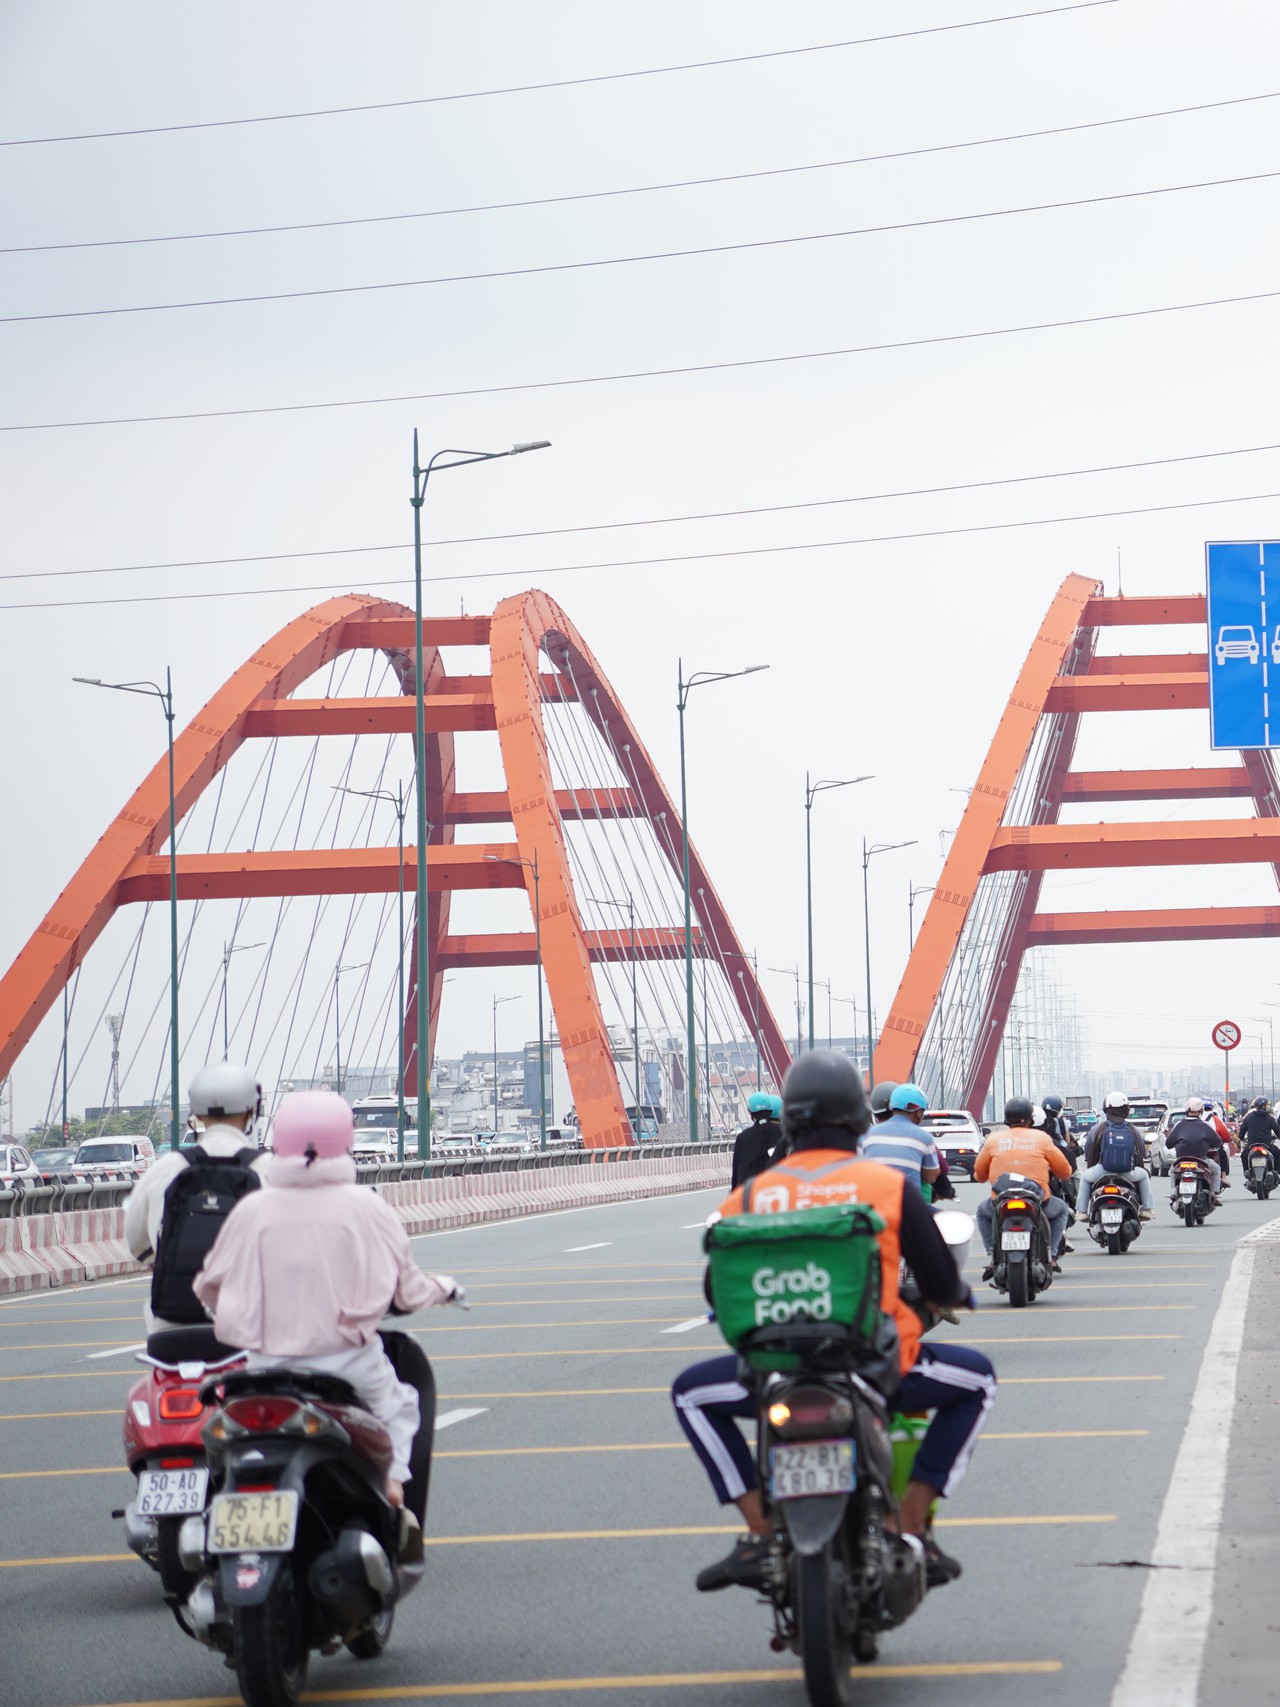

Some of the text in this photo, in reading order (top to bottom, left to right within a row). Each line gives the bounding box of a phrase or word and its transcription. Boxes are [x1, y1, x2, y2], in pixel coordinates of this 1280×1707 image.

[796, 1182, 857, 1197] Shopee
[754, 1263, 830, 1296] Grab
[150, 1472, 197, 1492] 50-AD
[142, 1492, 199, 1512] 627.39
[226, 1496, 282, 1521] 75-F1
[214, 1523, 289, 1548] 554.46
